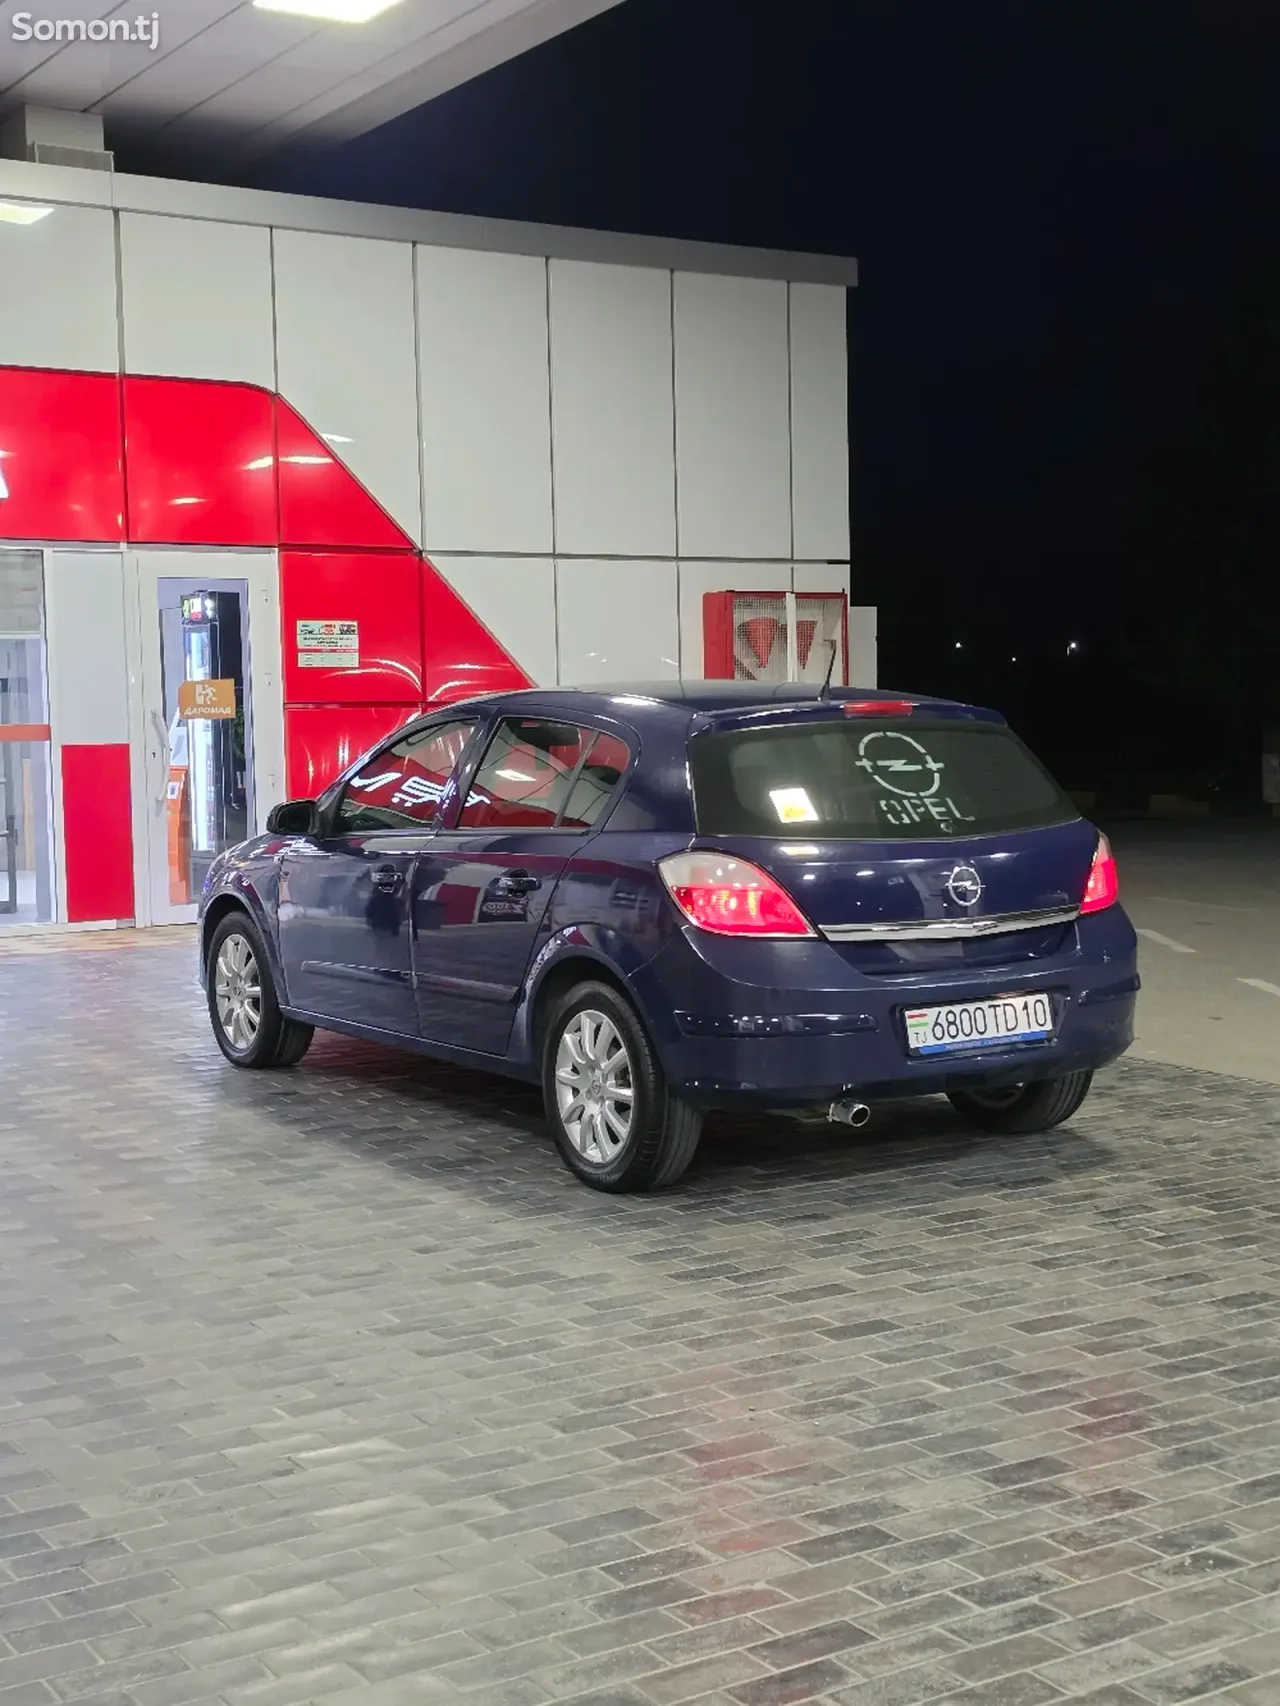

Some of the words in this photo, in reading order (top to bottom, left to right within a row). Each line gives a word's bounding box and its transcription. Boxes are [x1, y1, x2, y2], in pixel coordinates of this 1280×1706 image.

[183, 705, 232, 716] ДАРОМАД
[879, 797, 976, 824] OPEL
[931, 999, 1047, 1041] 6800TD10
[914, 1031, 928, 1044] TJ
